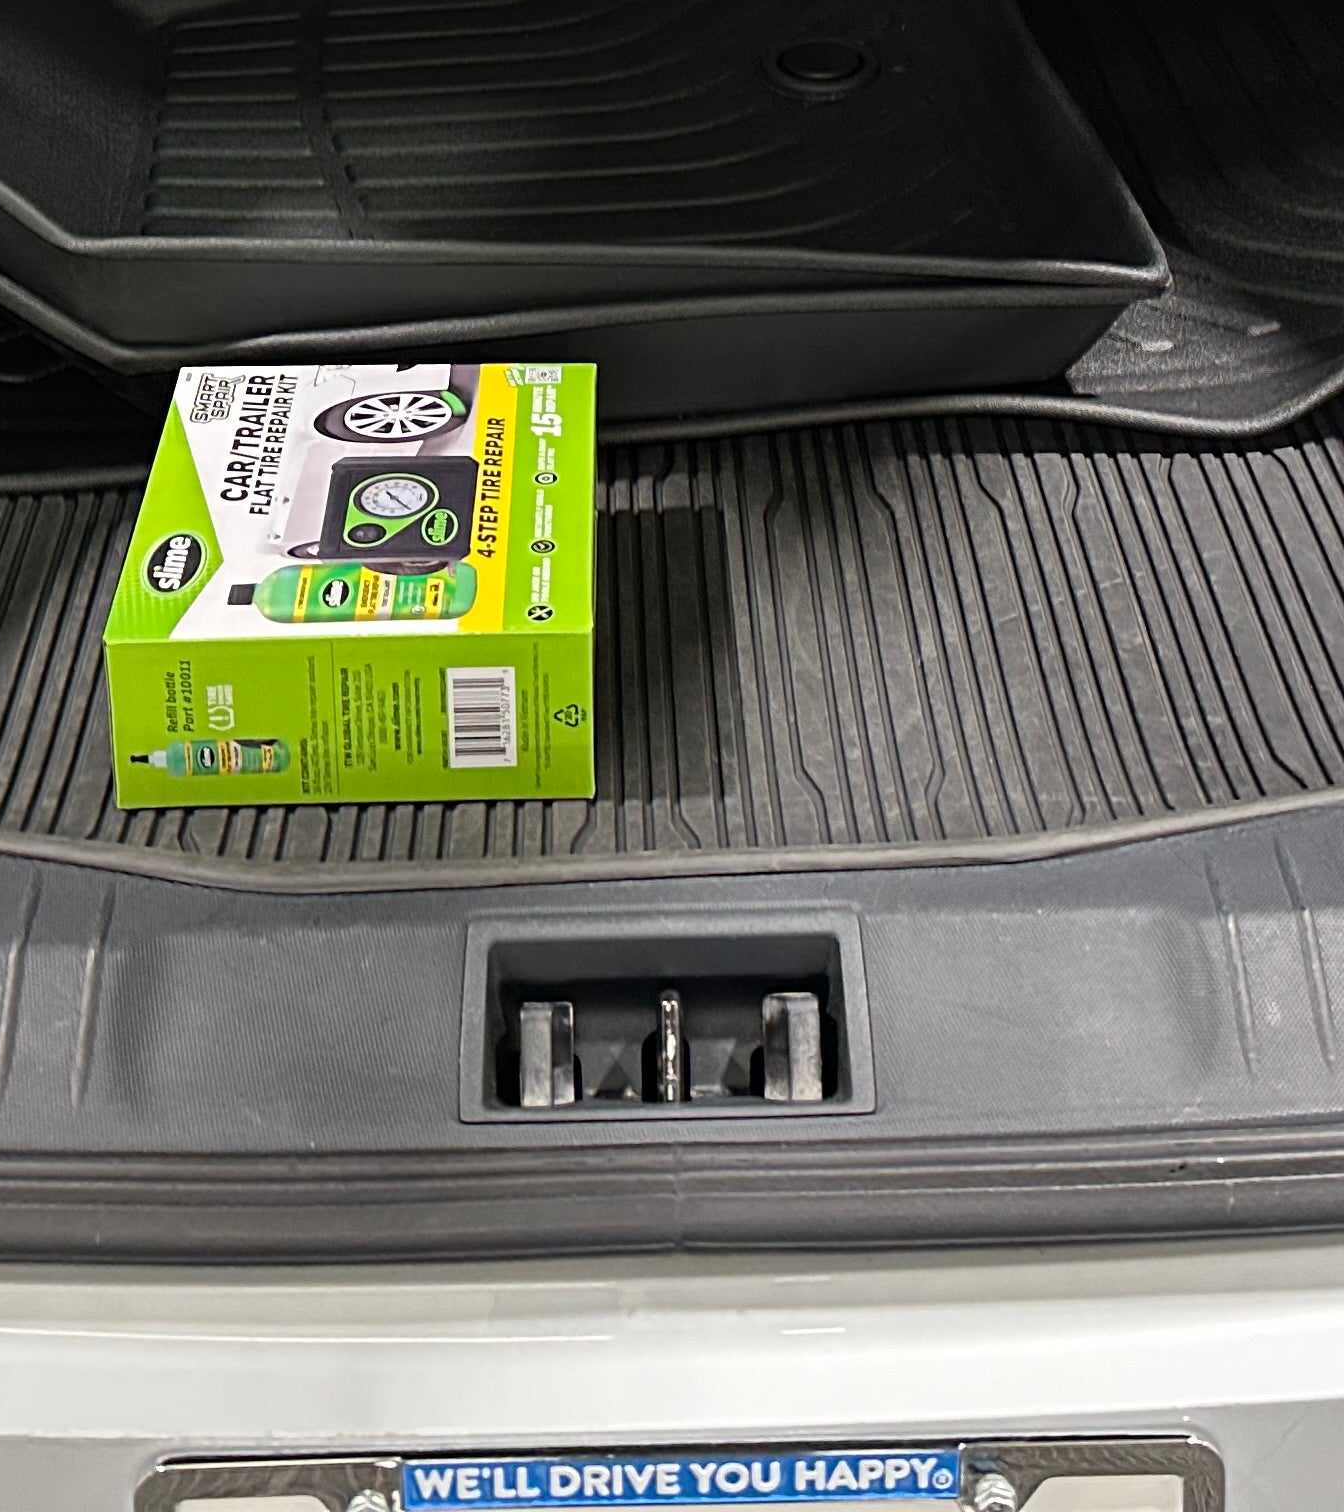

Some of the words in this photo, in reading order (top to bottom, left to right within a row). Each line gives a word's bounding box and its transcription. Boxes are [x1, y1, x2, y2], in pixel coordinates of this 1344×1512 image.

[195, 375, 218, 422] SMART
[275, 373, 298, 395] KIT
[220, 375, 275, 502] CAR/TRAILER
[265, 396, 293, 444] REPAIR
[531, 412, 562, 437] 15
[483, 418, 506, 467] REPAIR
[258, 446, 283, 478] TIRE
[249, 479, 274, 516] FLAT
[480, 470, 502, 501] TIRE
[477, 505, 499, 559] 4-STEP
[152, 534, 192, 591] slime
[164, 671, 177, 704] bottle
[179, 659, 193, 704] #10011
[166, 704, 179, 734] Refill
[182, 706, 195, 733] Part
[414, 1466, 541, 1500] WE'LL
[549, 1462, 682, 1497] DRIVE
[688, 1460, 781, 1494] YOU
